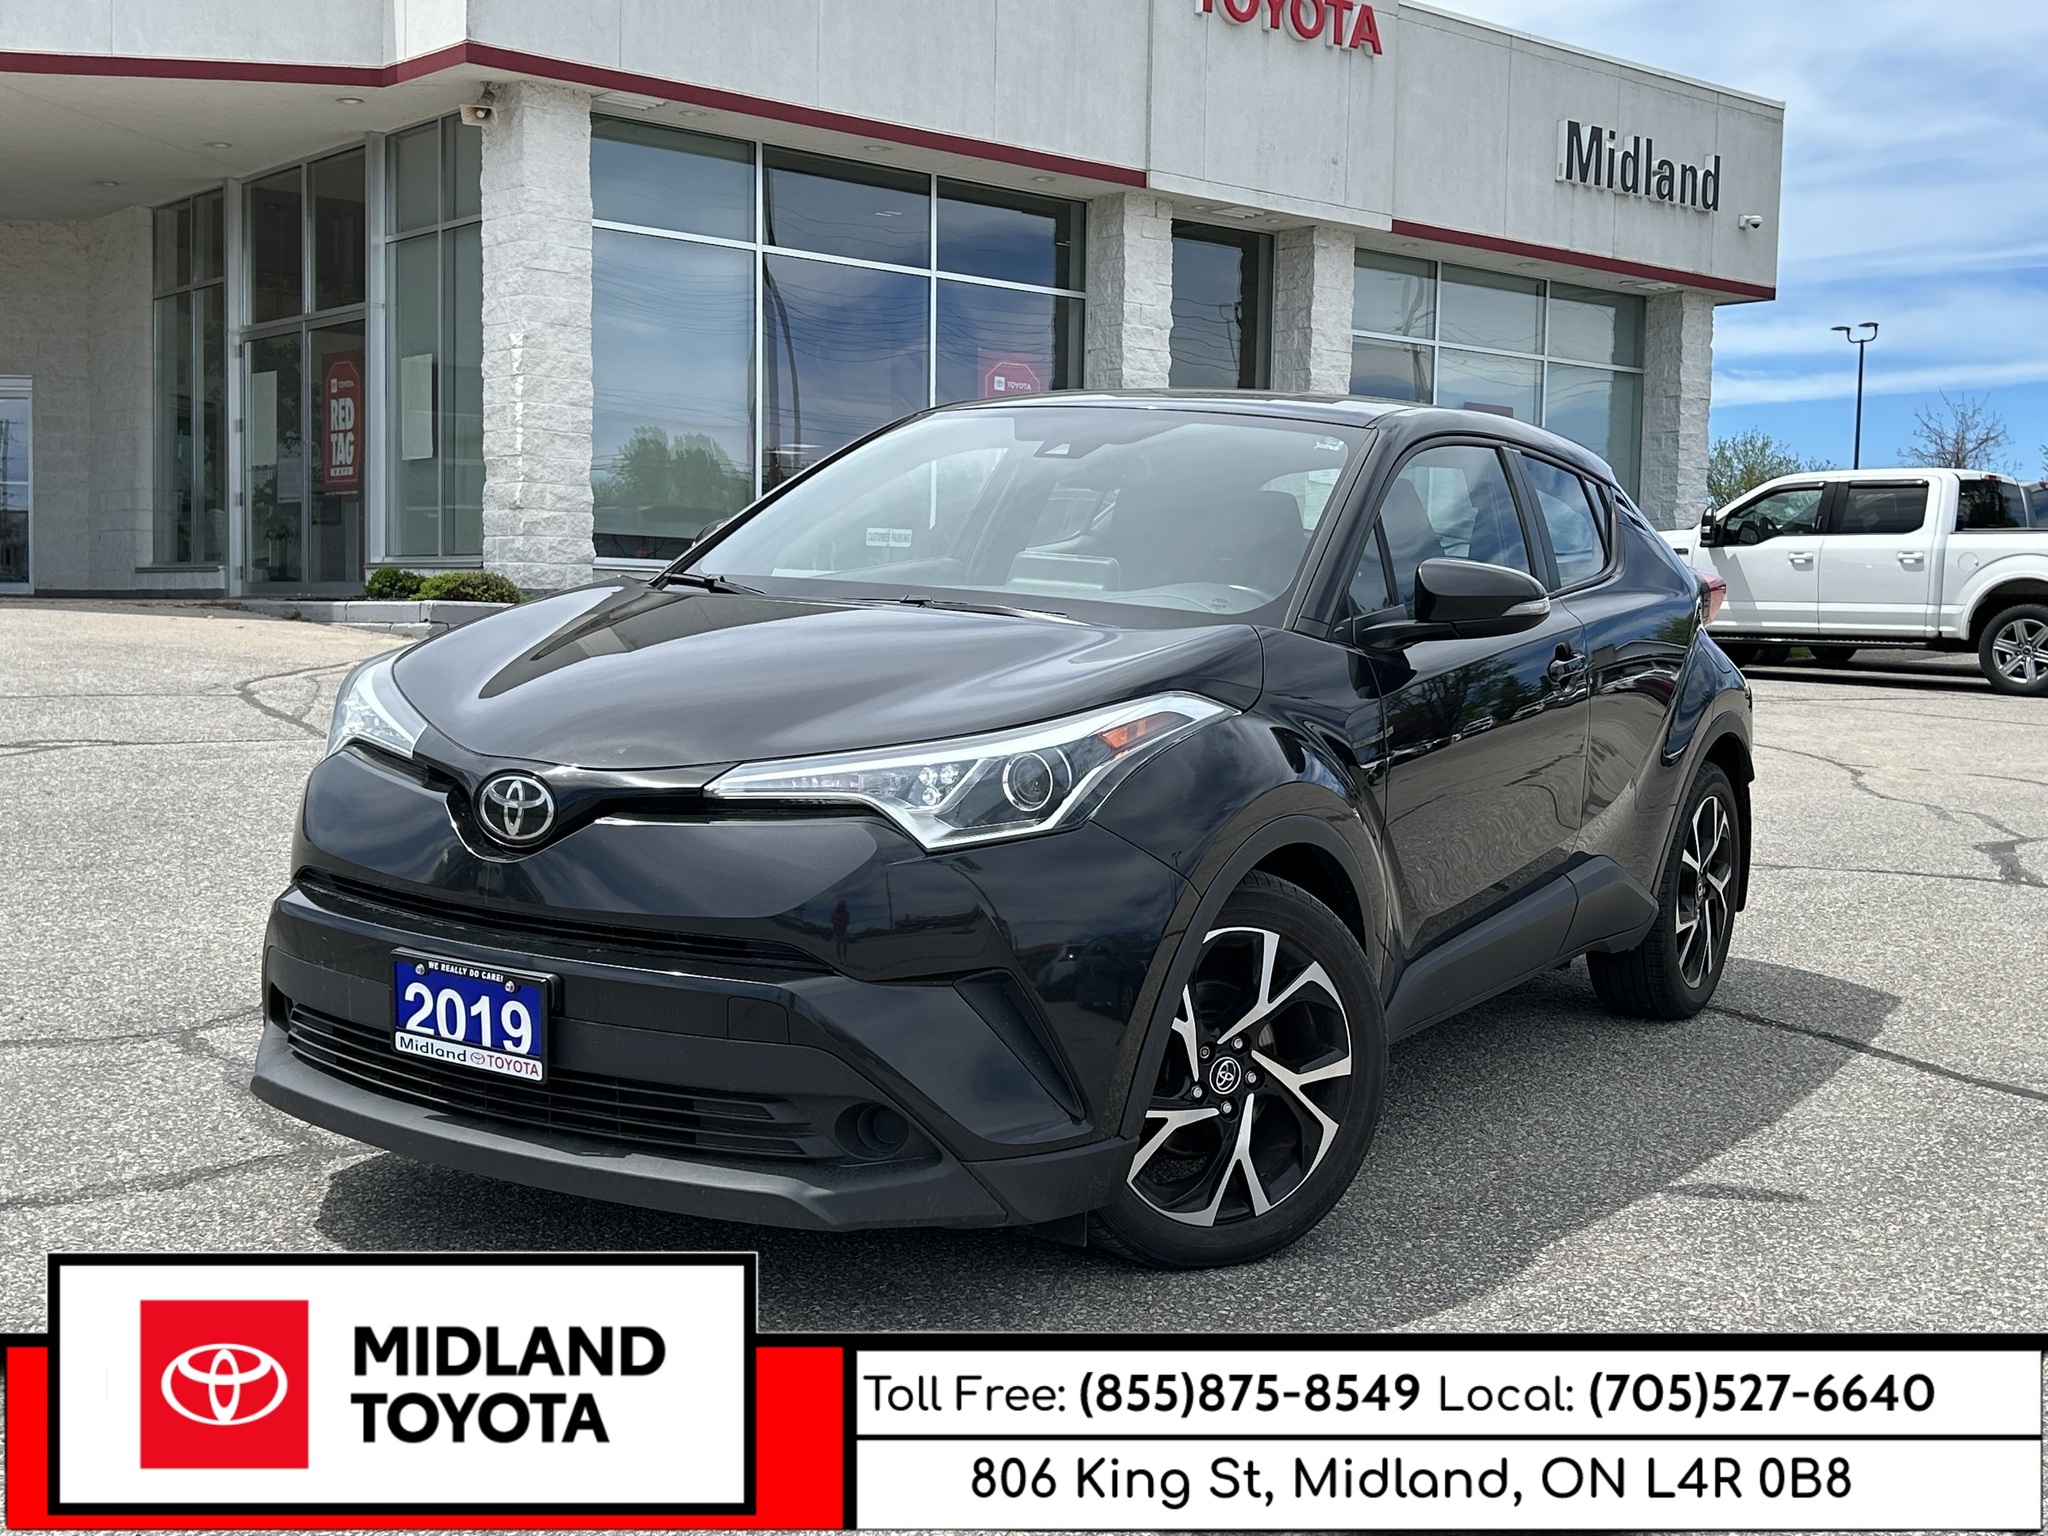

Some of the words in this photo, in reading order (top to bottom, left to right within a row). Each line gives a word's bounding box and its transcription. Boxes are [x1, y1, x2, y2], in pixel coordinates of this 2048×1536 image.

[1202, 0, 1382, 55] YOTA
[1564, 119, 1721, 212] Midland
[1006, 381, 1032, 390] TOYOTA
[330, 397, 355, 432] RED
[330, 431, 355, 466] TAG
[428, 961, 439, 970] WE
[440, 963, 467, 976] REALLY
[469, 969, 480, 978] DO
[481, 972, 504, 983] CARE!
[404, 982, 532, 1055] 2019
[400, 1036, 467, 1062] Midland
[487, 1054, 540, 1077] TOYOTA
